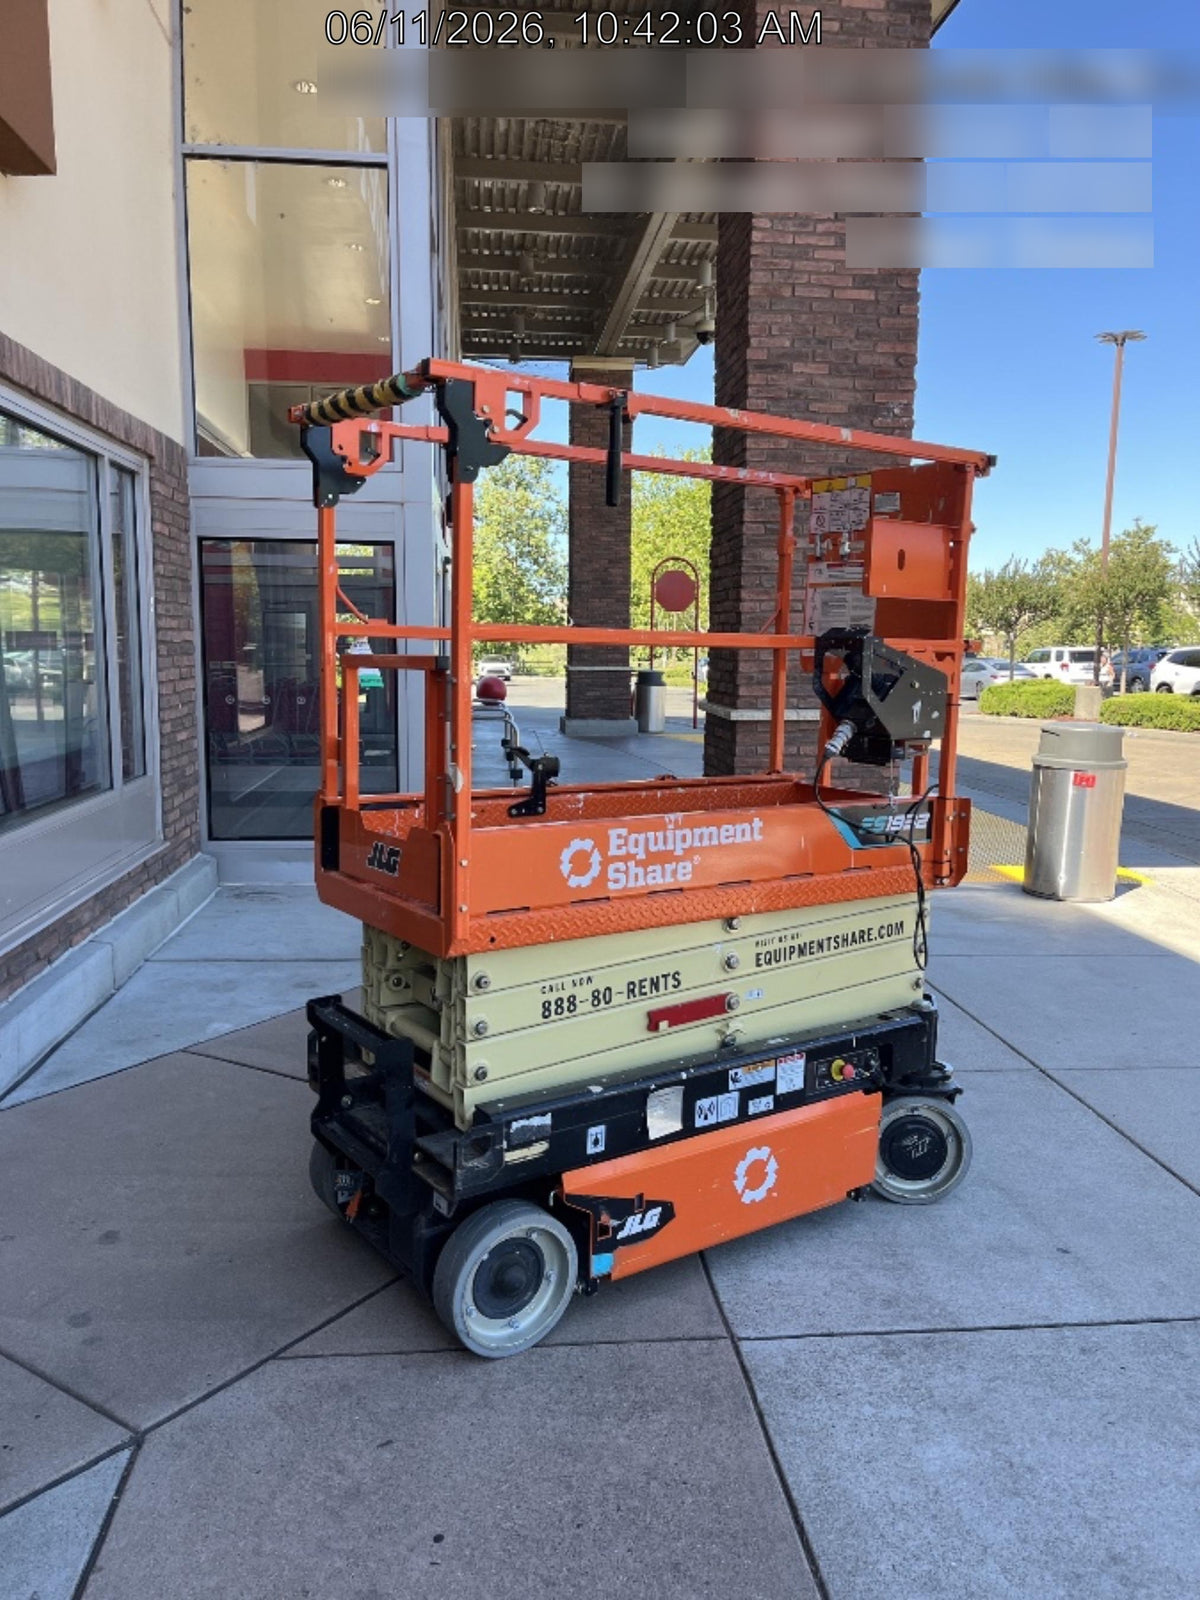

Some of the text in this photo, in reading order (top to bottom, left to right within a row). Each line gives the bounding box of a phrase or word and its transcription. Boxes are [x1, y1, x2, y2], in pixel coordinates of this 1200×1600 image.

[607, 817, 763, 859] Equipment
[755, 920, 905, 968] EQUIPMENTSHARE.COM
[540, 981, 566, 995] CALL
[541, 970, 682, 1020] 888-80-RENTS
[616, 1206, 662, 1240] JLG
